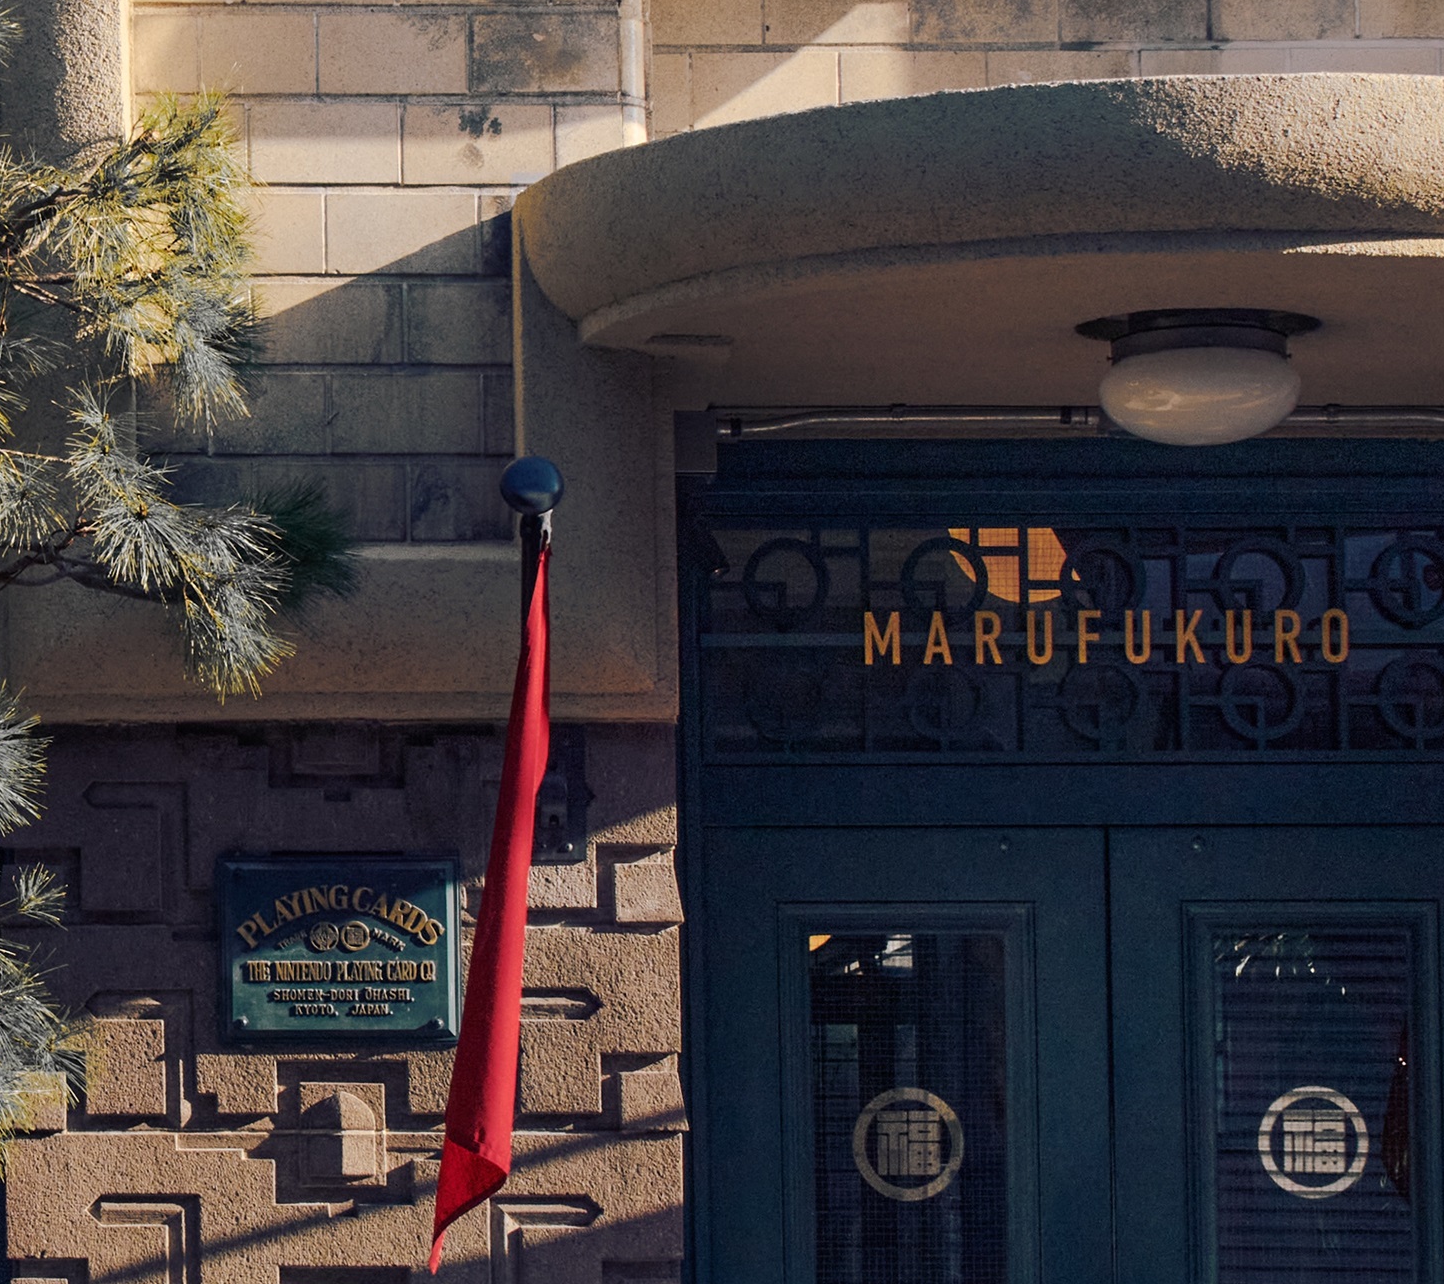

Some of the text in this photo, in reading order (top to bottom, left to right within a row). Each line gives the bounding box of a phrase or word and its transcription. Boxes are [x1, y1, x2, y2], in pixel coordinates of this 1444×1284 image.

[864, 608, 1351, 665] MARUFUKURO
[236, 884, 349, 950] PLAYING
[352, 885, 446, 946] CARDS
[372, 928, 407, 952] MARK
[247, 960, 271, 982] THE
[275, 960, 332, 982] NINTENDO
[336, 960, 383, 982] PLAYING
[386, 960, 417, 982] CARD
[273, 987, 359, 1002] SHOMEN-DORI
